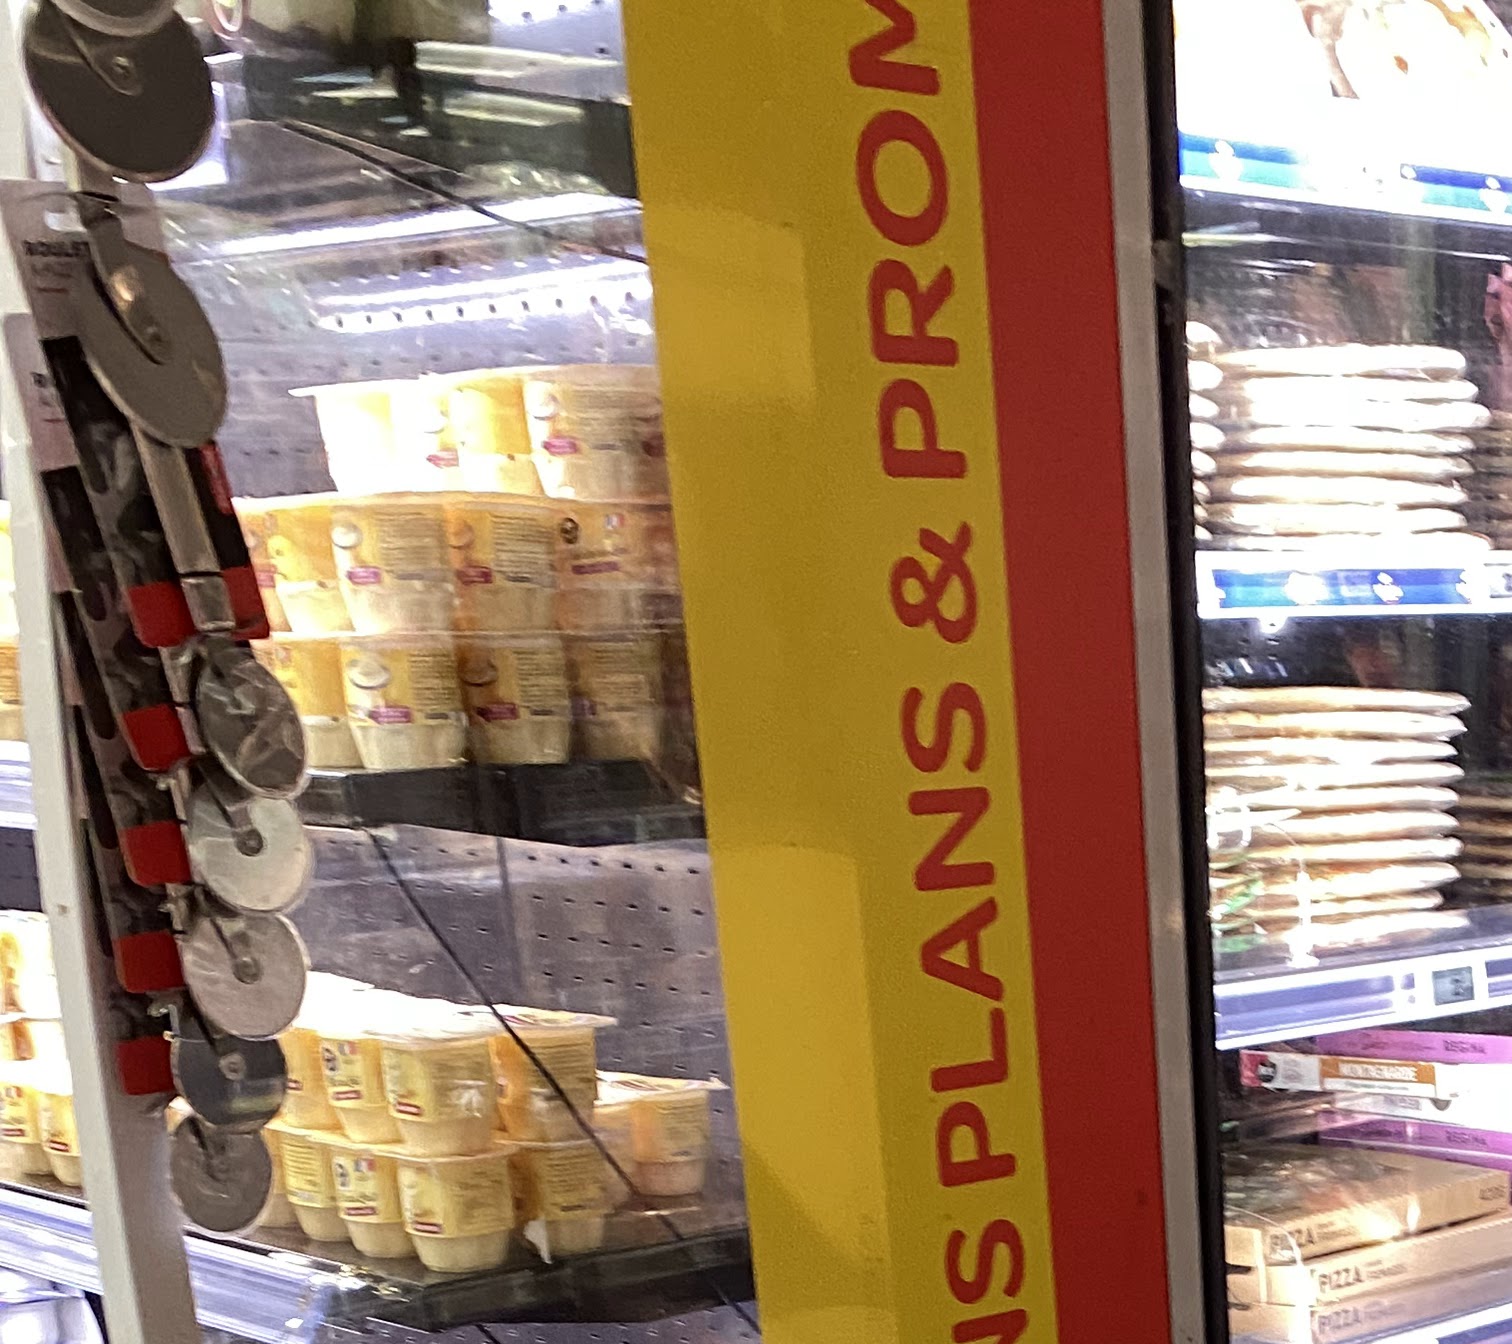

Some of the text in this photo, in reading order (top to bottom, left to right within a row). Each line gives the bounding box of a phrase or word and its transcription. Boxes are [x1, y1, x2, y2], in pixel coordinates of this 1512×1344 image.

[849, 0, 968, 480] PROM
[890, 524, 978, 644] &
[901, 682, 1017, 1188] PLANS
[1319, 1264, 1364, 1294] PIZZA
